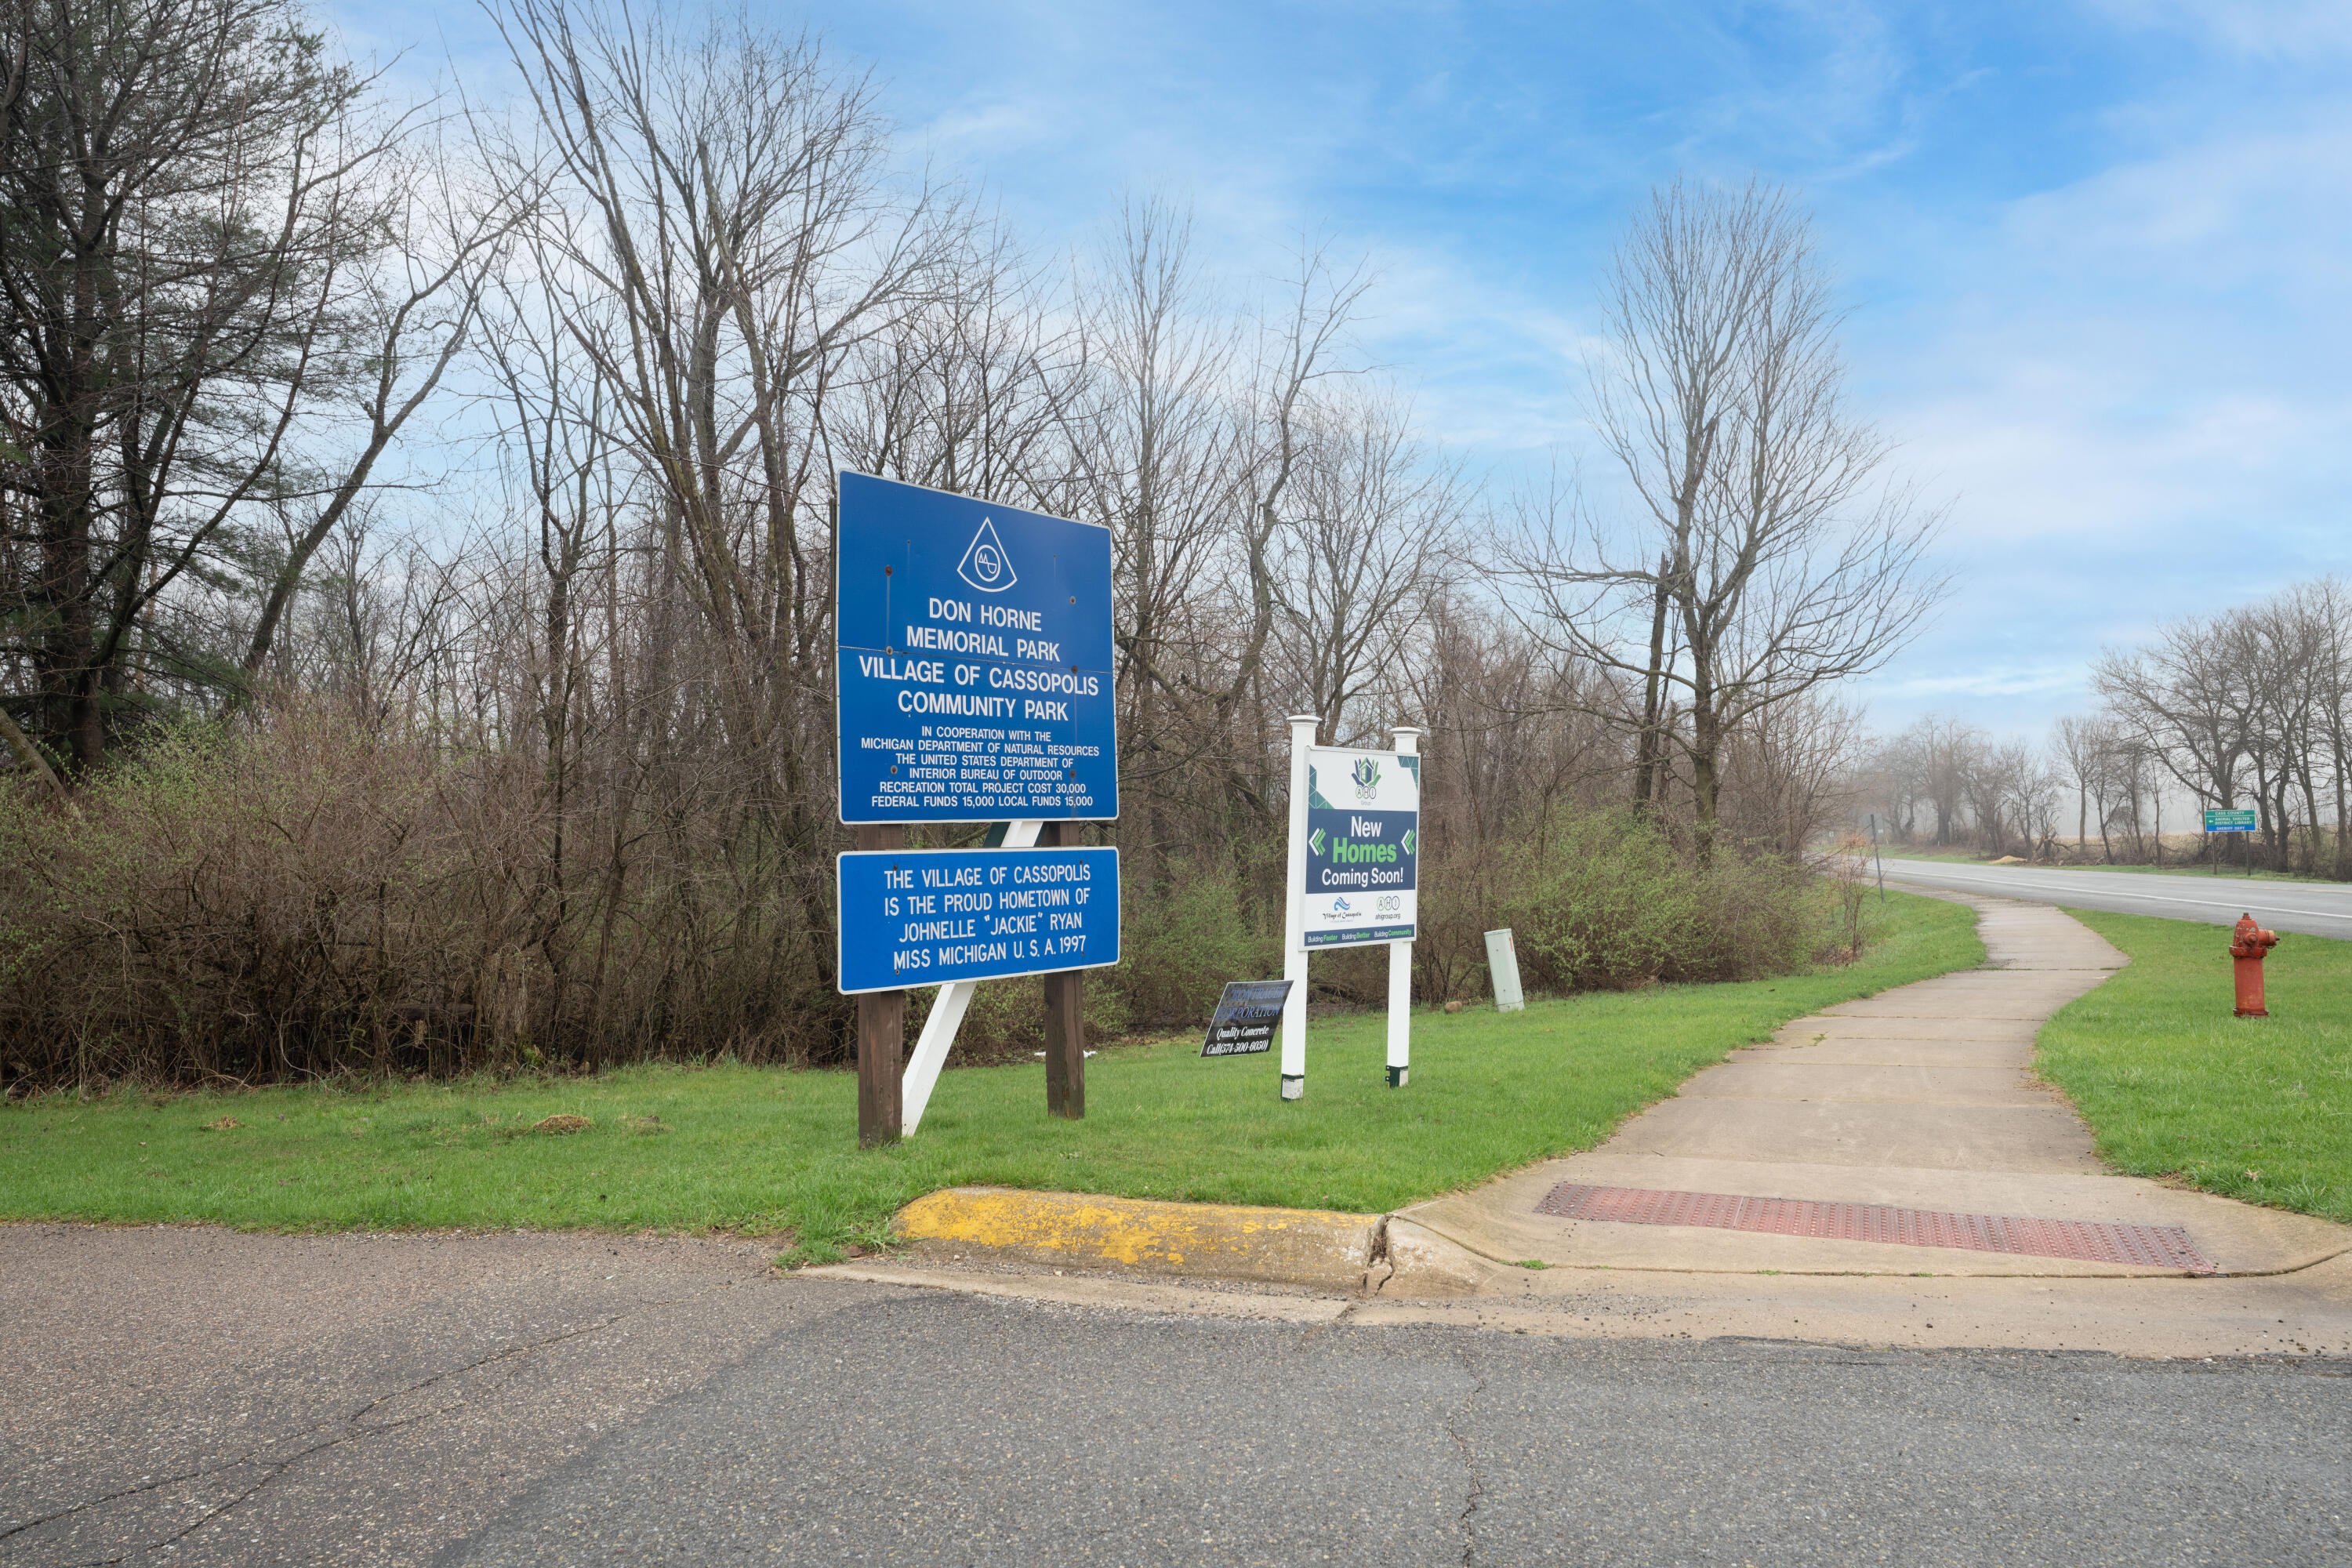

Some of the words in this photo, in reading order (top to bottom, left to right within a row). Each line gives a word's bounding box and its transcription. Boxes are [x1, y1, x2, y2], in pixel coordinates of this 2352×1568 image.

[929, 597, 971, 622] DON
[981, 604, 1042, 632] HORNE
[906, 626, 1009, 657] MEMORIAL
[1017, 638, 1060, 662] PARK
[859, 657, 944, 684] VILLAGE
[955, 665, 981, 685] OF
[989, 667, 1098, 695] CASSOPOLIS
[898, 690, 1016, 718] COMMUNITY
[1025, 701, 1069, 721] PARK
[922, 726, 931, 736] IN
[937, 726, 1004, 739] COOPERATION
[1008, 730, 1031, 740] WITH
[1035, 731, 1051, 742] THE
[861, 738, 913, 750] MICHIGAN
[918, 740, 982, 753] DEPARTMENT
[988, 743, 1000, 753] OF
[1004, 744, 1044, 755] NATURAL
[1047, 745, 1099, 756] RESOURCES
[896, 753, 916, 764] THE
[921, 753, 957, 765] UNITED
[962, 756, 996, 766] STATES
[1000, 757, 1058, 767] DEPARTMENT
[1062, 758, 1073, 768] OF
[909, 768, 957, 779] INTERIOR
[961, 768, 999, 779] BUREAU
[1004, 769, 1015, 780] OF
[1019, 770, 1062, 780] OUTDOOR
[880, 782, 945, 793] RECREATION
[949, 782, 978, 793] TOTAL
[982, 782, 1024, 793] PROJECT
[1028, 783, 1052, 793] COST
[1055, 783, 1086, 795] 30,000
[872, 796, 919, 807] FEDERAL
[924, 796, 957, 807] FUNDS
[962, 796, 994, 808] 15,000
[999, 797, 1029, 807] LOCAL
[1033, 797, 1061, 806] FUNDS
[1065, 797, 1093, 808] 15,000
[1351, 816, 1381, 837] New
[1333, 837, 1396, 862] Homes
[884, 870, 914, 889] THE
[922, 868, 982, 887] VILLAGE
[990, 866, 1007, 885] OF
[1014, 864, 1091, 884] CASSOPOLIS
[1322, 868, 1369, 887] Coming
[1371, 867, 1403, 884] Soon!
[884, 897, 899, 916] IS
[907, 895, 935, 915] THE
[944, 893, 992, 913] PROUD
[1000, 889, 1069, 909] HOMETOWN
[1076, 888, 1091, 906] OF
[899, 920, 975, 942] JOHNELLE
[984, 912, 1044, 935] "JACKIE"
[1050, 913, 1082, 931] RYAN
[894, 949, 931, 971] MISS
[939, 942, 1006, 966] MICHIGAN
[1014, 940, 1025, 959] U.
[1029, 938, 1040, 957] S.
[1044, 938, 1056, 955] A.
[1060, 935, 1086, 953] 1997
[1217, 1027, 1240, 1040] Quality
[1241, 1025, 1269, 1037] Concrete
